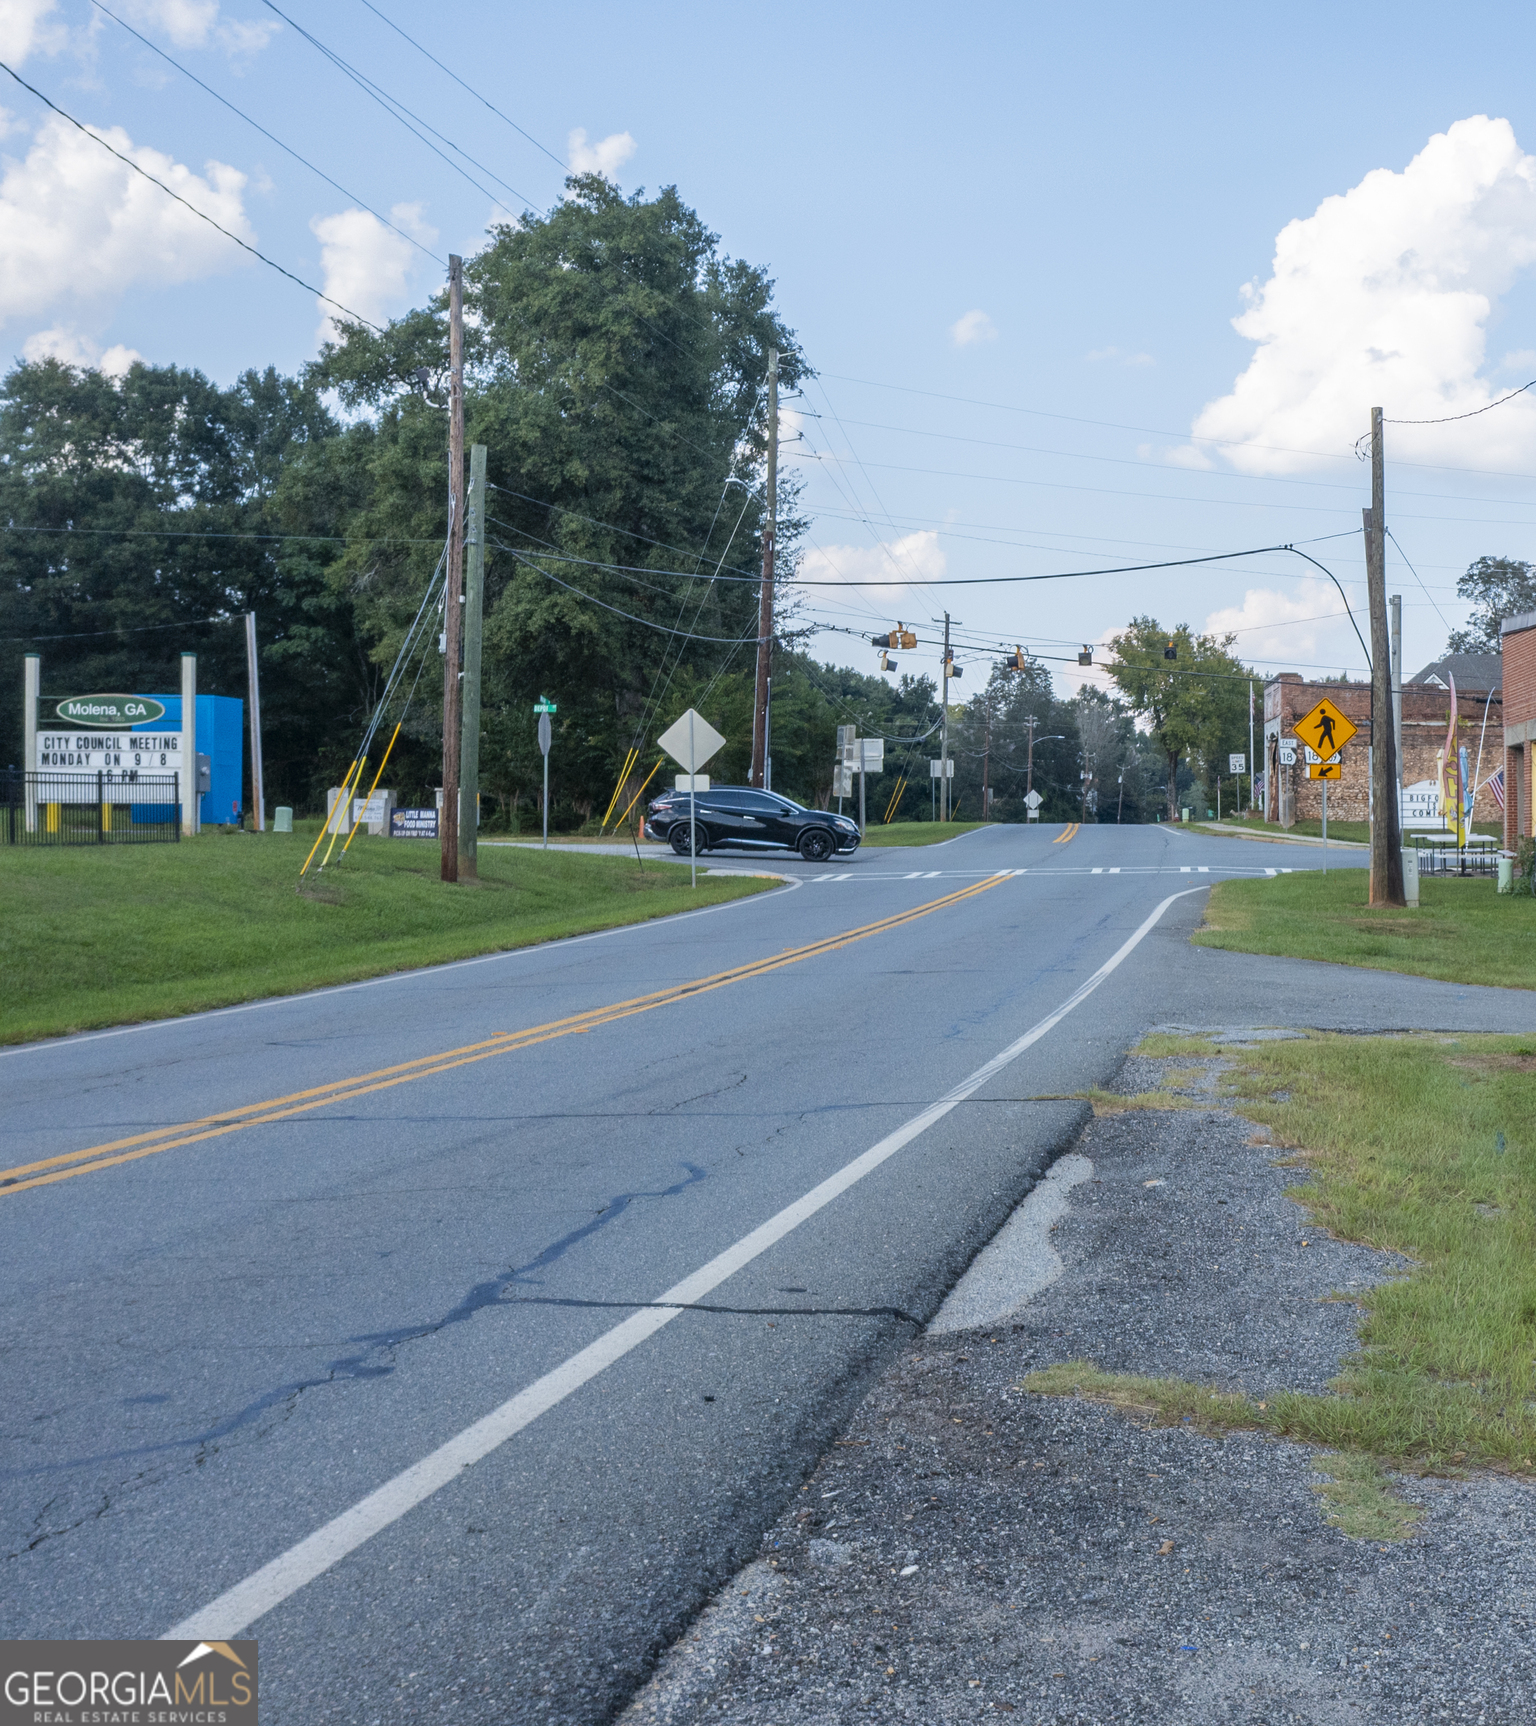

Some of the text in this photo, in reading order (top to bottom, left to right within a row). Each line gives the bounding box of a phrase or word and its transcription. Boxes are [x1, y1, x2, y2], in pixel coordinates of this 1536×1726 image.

[68, 703, 147, 717] Molena, GA
[44, 737, 178, 750] CITY COUNCIL MEETING
[41, 753, 91, 766] MONDAY
[105, 753, 121, 766] ON
[1282, 752, 1293, 762] 18
[1308, 751, 1319, 761] 18
[1231, 763, 1244, 771] 35
[405, 810, 419, 819] LITTLE
[404, 820, 437, 828] FOOD MINISTRY
